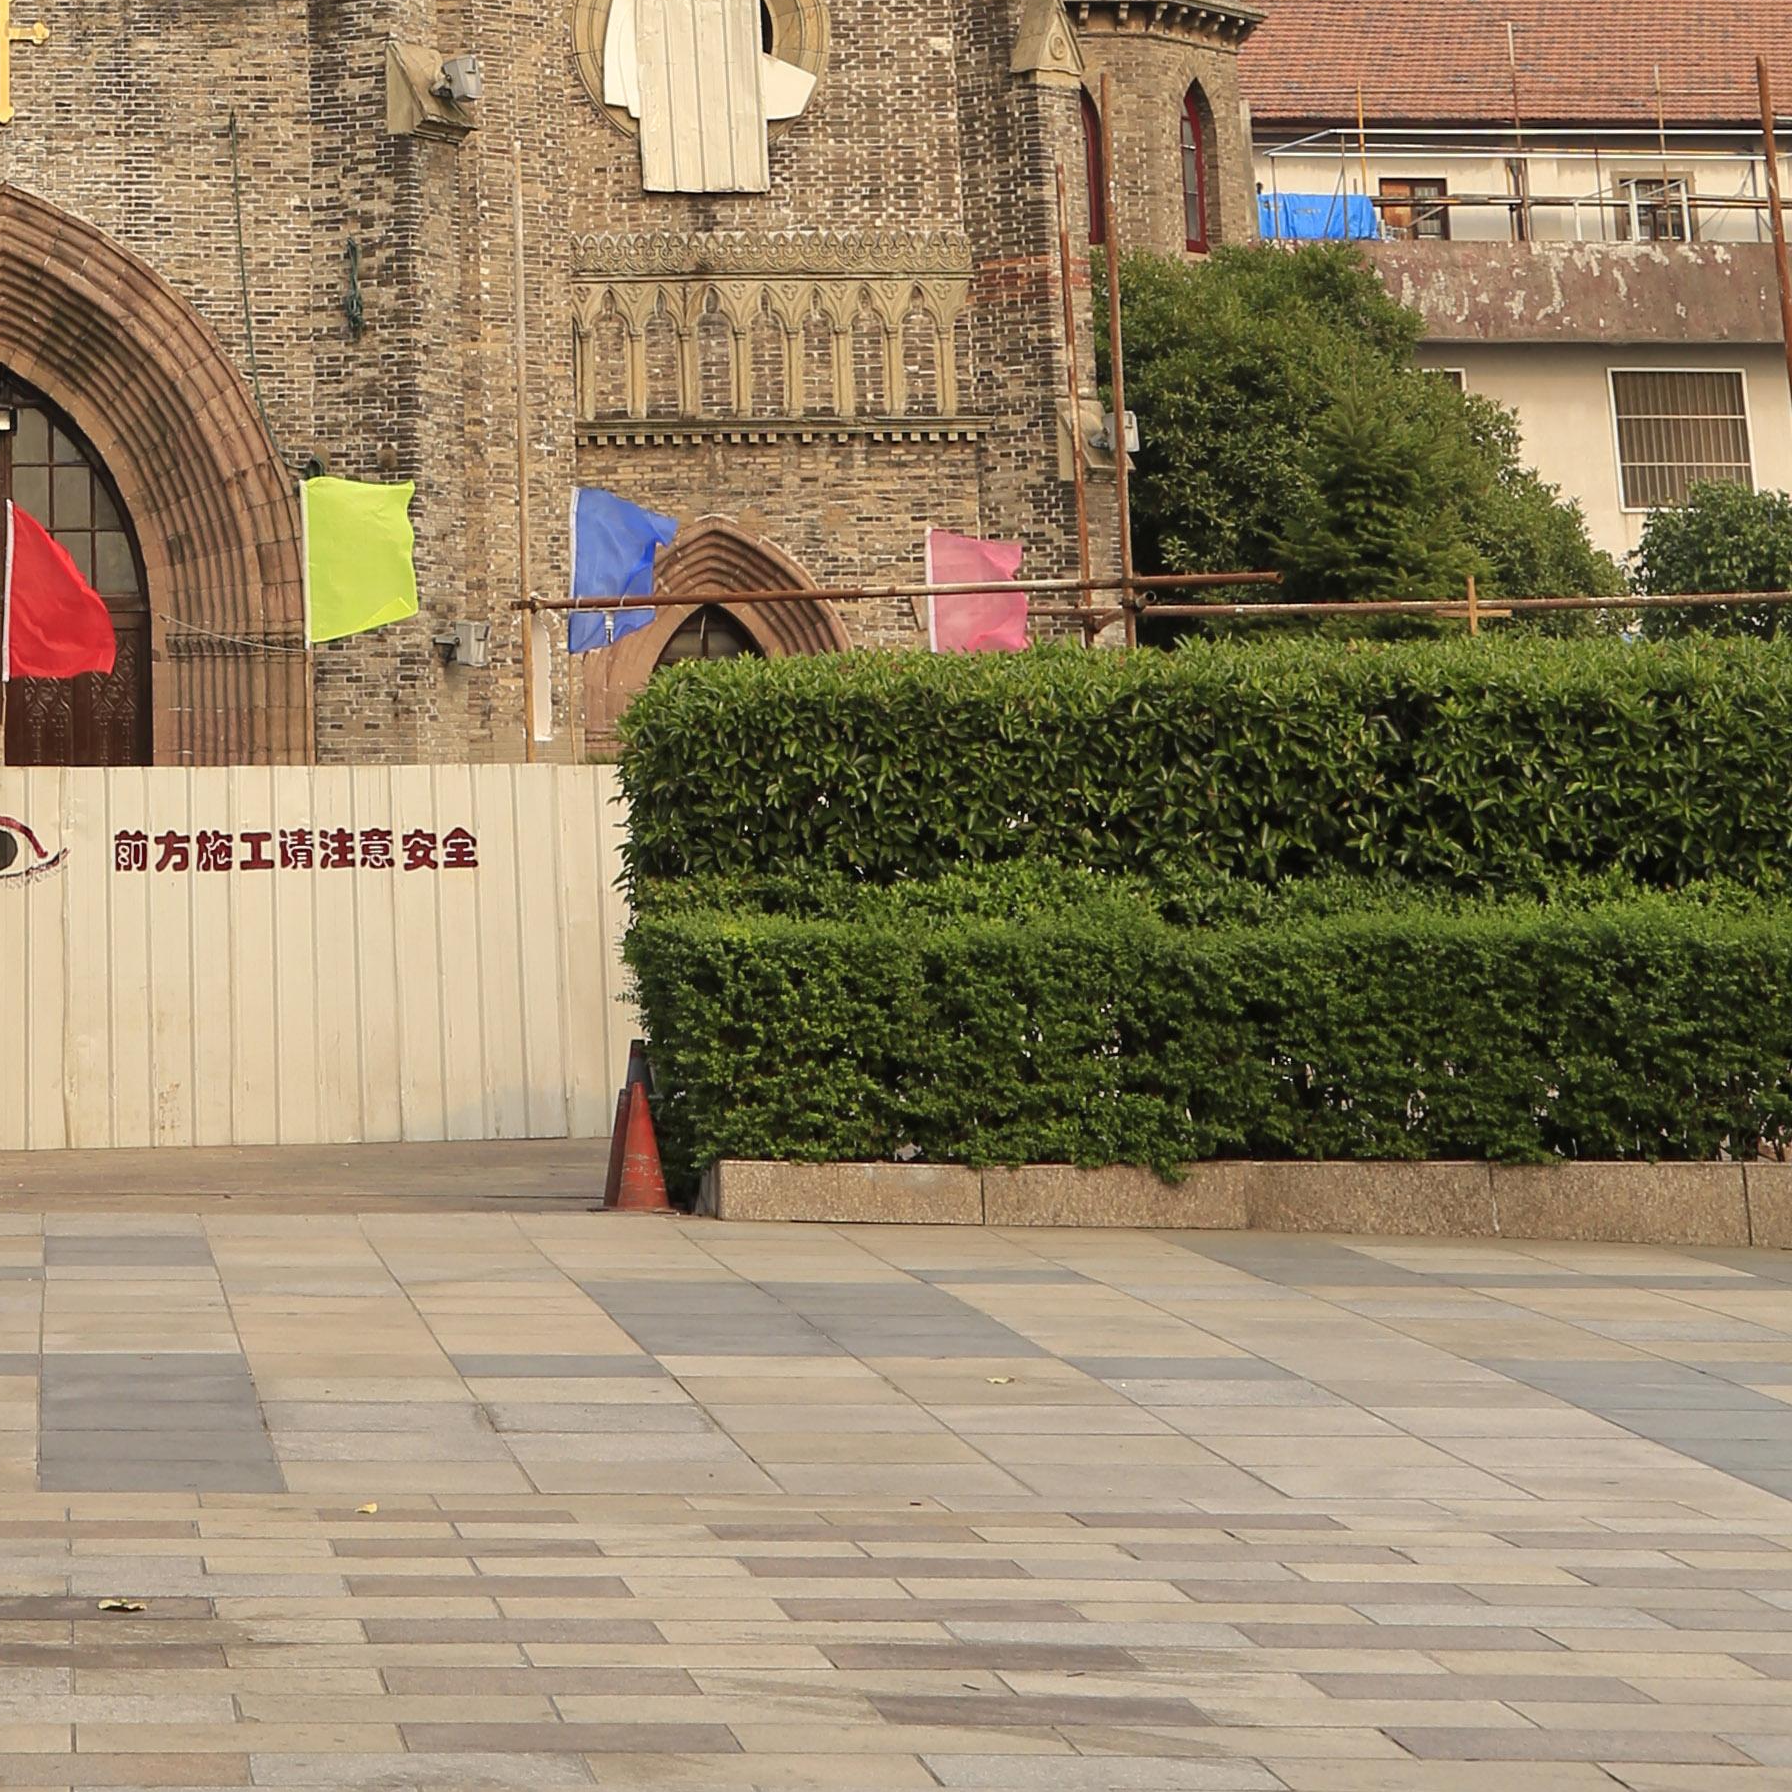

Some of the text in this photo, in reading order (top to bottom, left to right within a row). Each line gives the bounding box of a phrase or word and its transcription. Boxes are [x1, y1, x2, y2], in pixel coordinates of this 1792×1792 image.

[113, 827, 479, 872] 前方施工请注意安全
